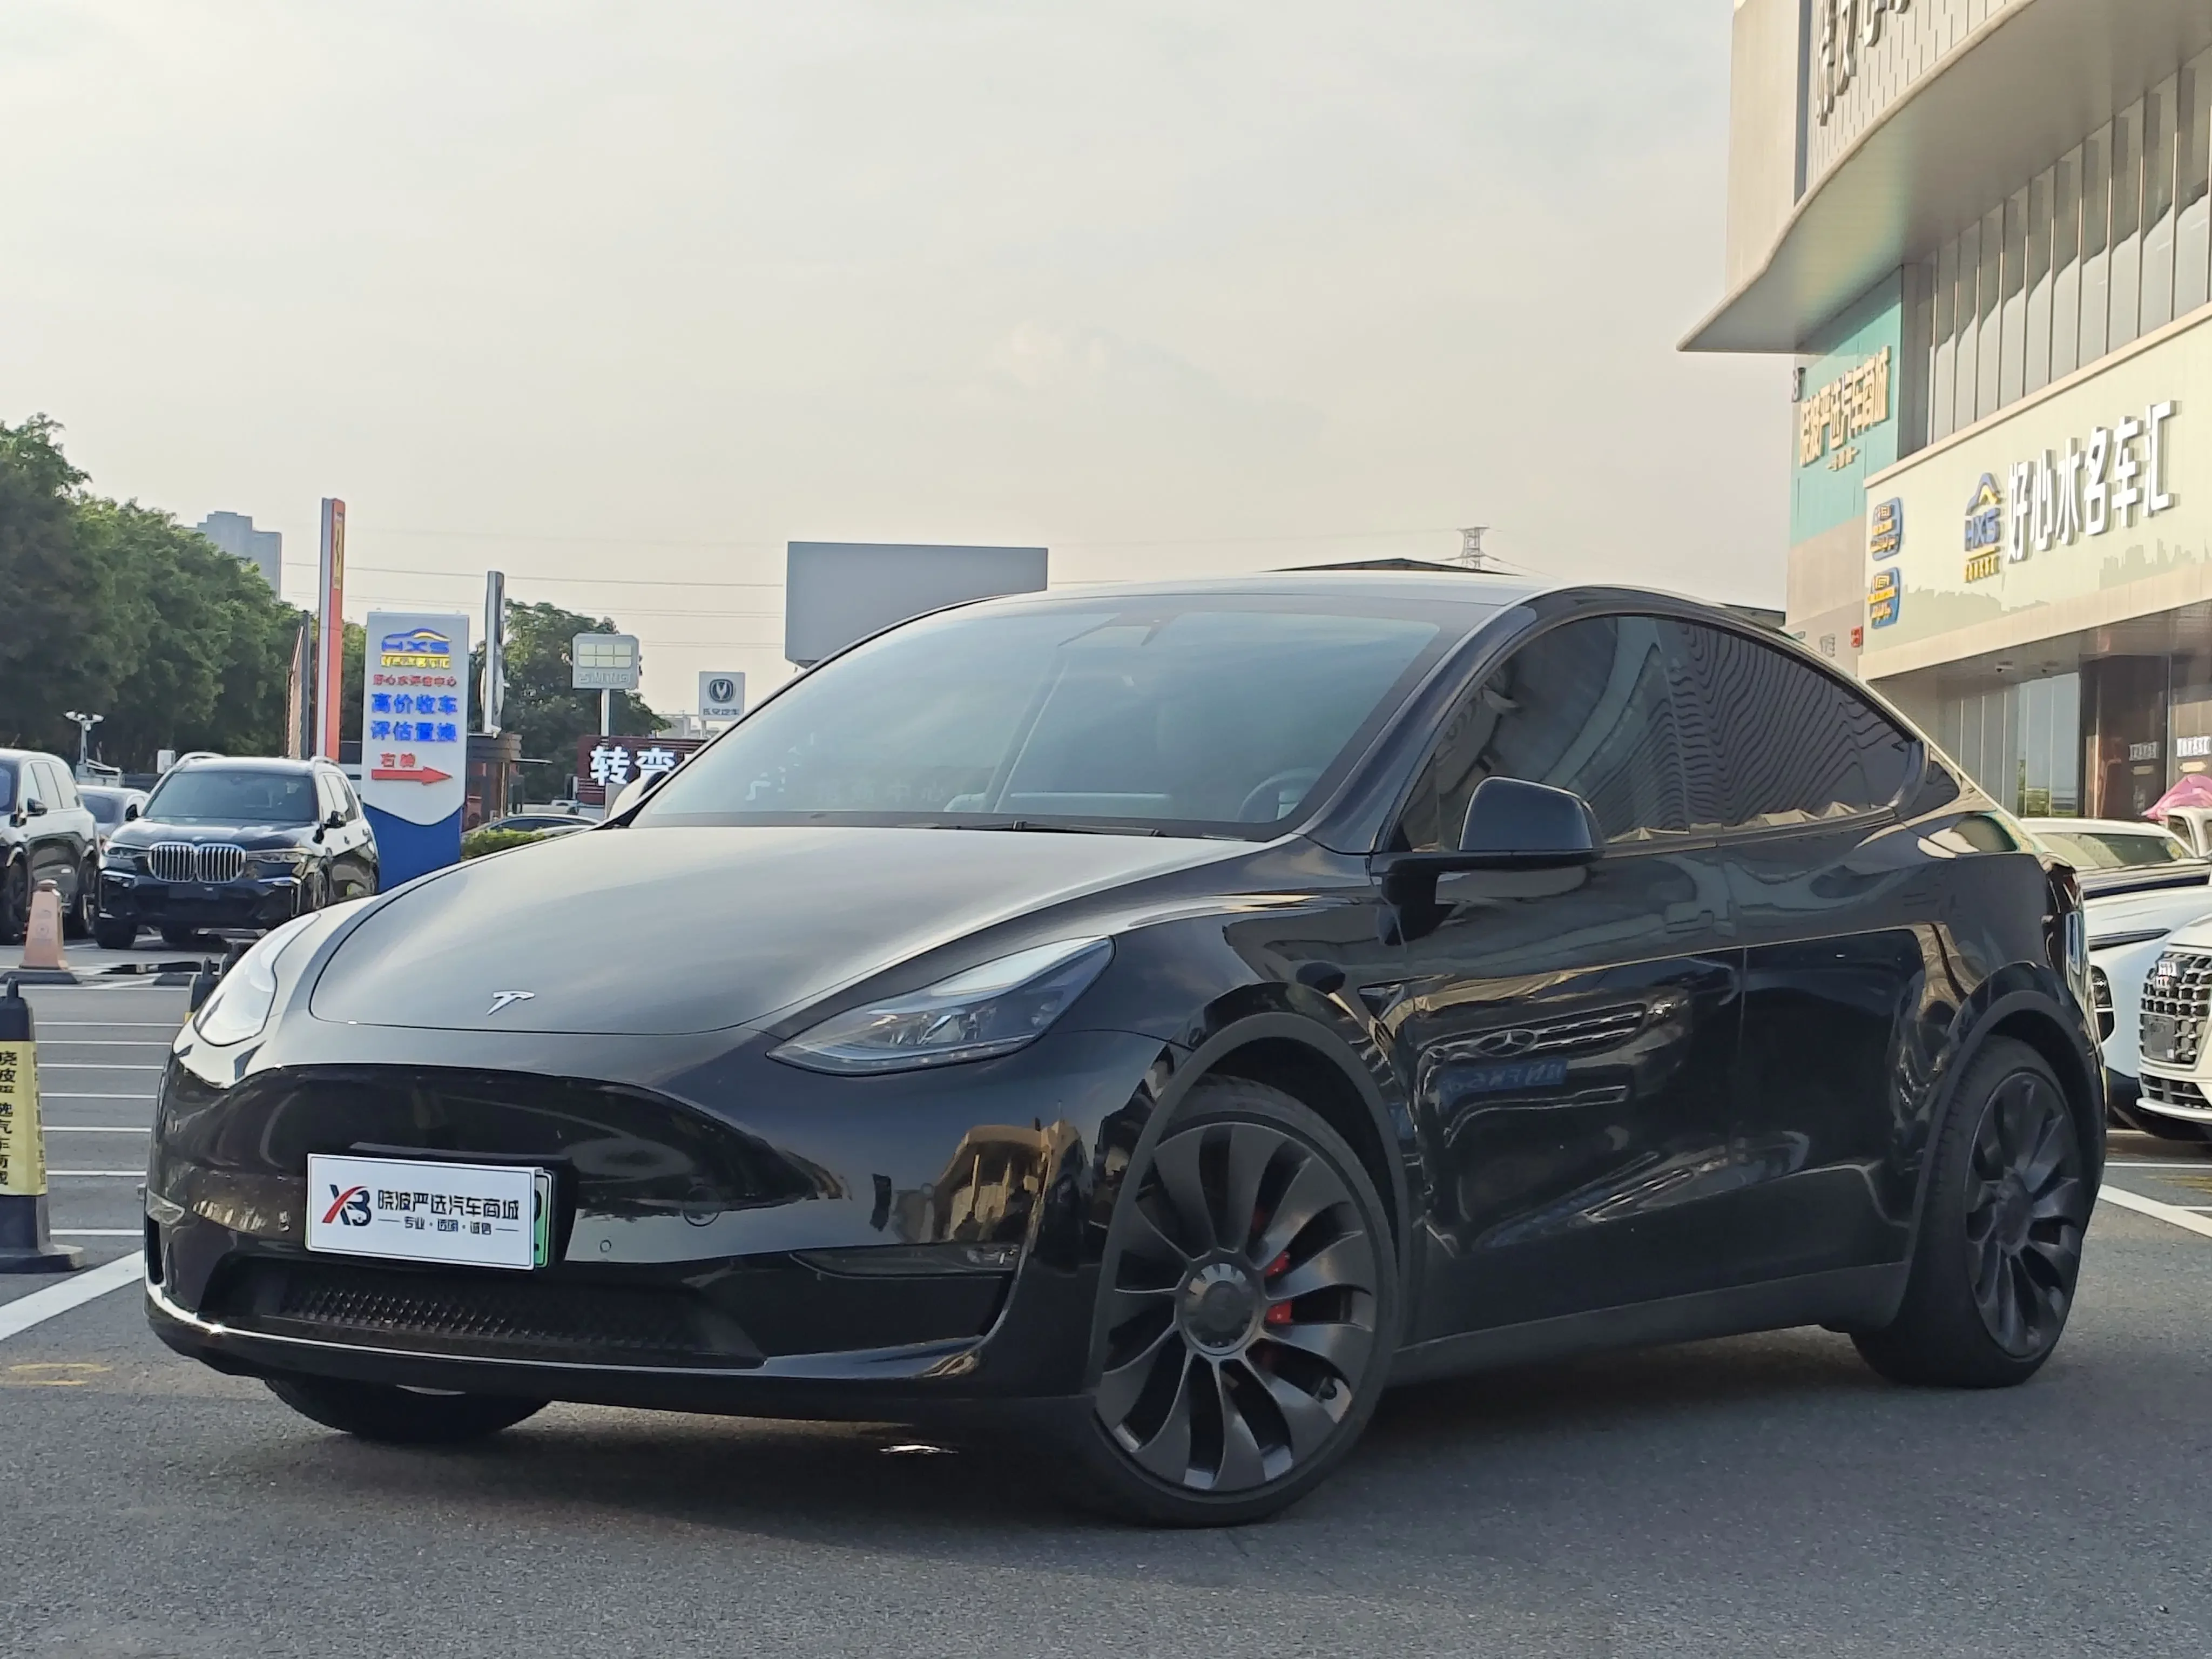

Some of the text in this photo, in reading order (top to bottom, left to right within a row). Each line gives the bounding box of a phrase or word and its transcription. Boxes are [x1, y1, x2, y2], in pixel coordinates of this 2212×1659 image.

[2007, 400, 2176, 564] 好心水名车汇
[381, 640, 450, 654] HXS
[372, 693, 457, 715] 高价收车
[322, 1184, 372, 1227] XB
[377, 1190, 520, 1220] 晓波严选汽车商城
